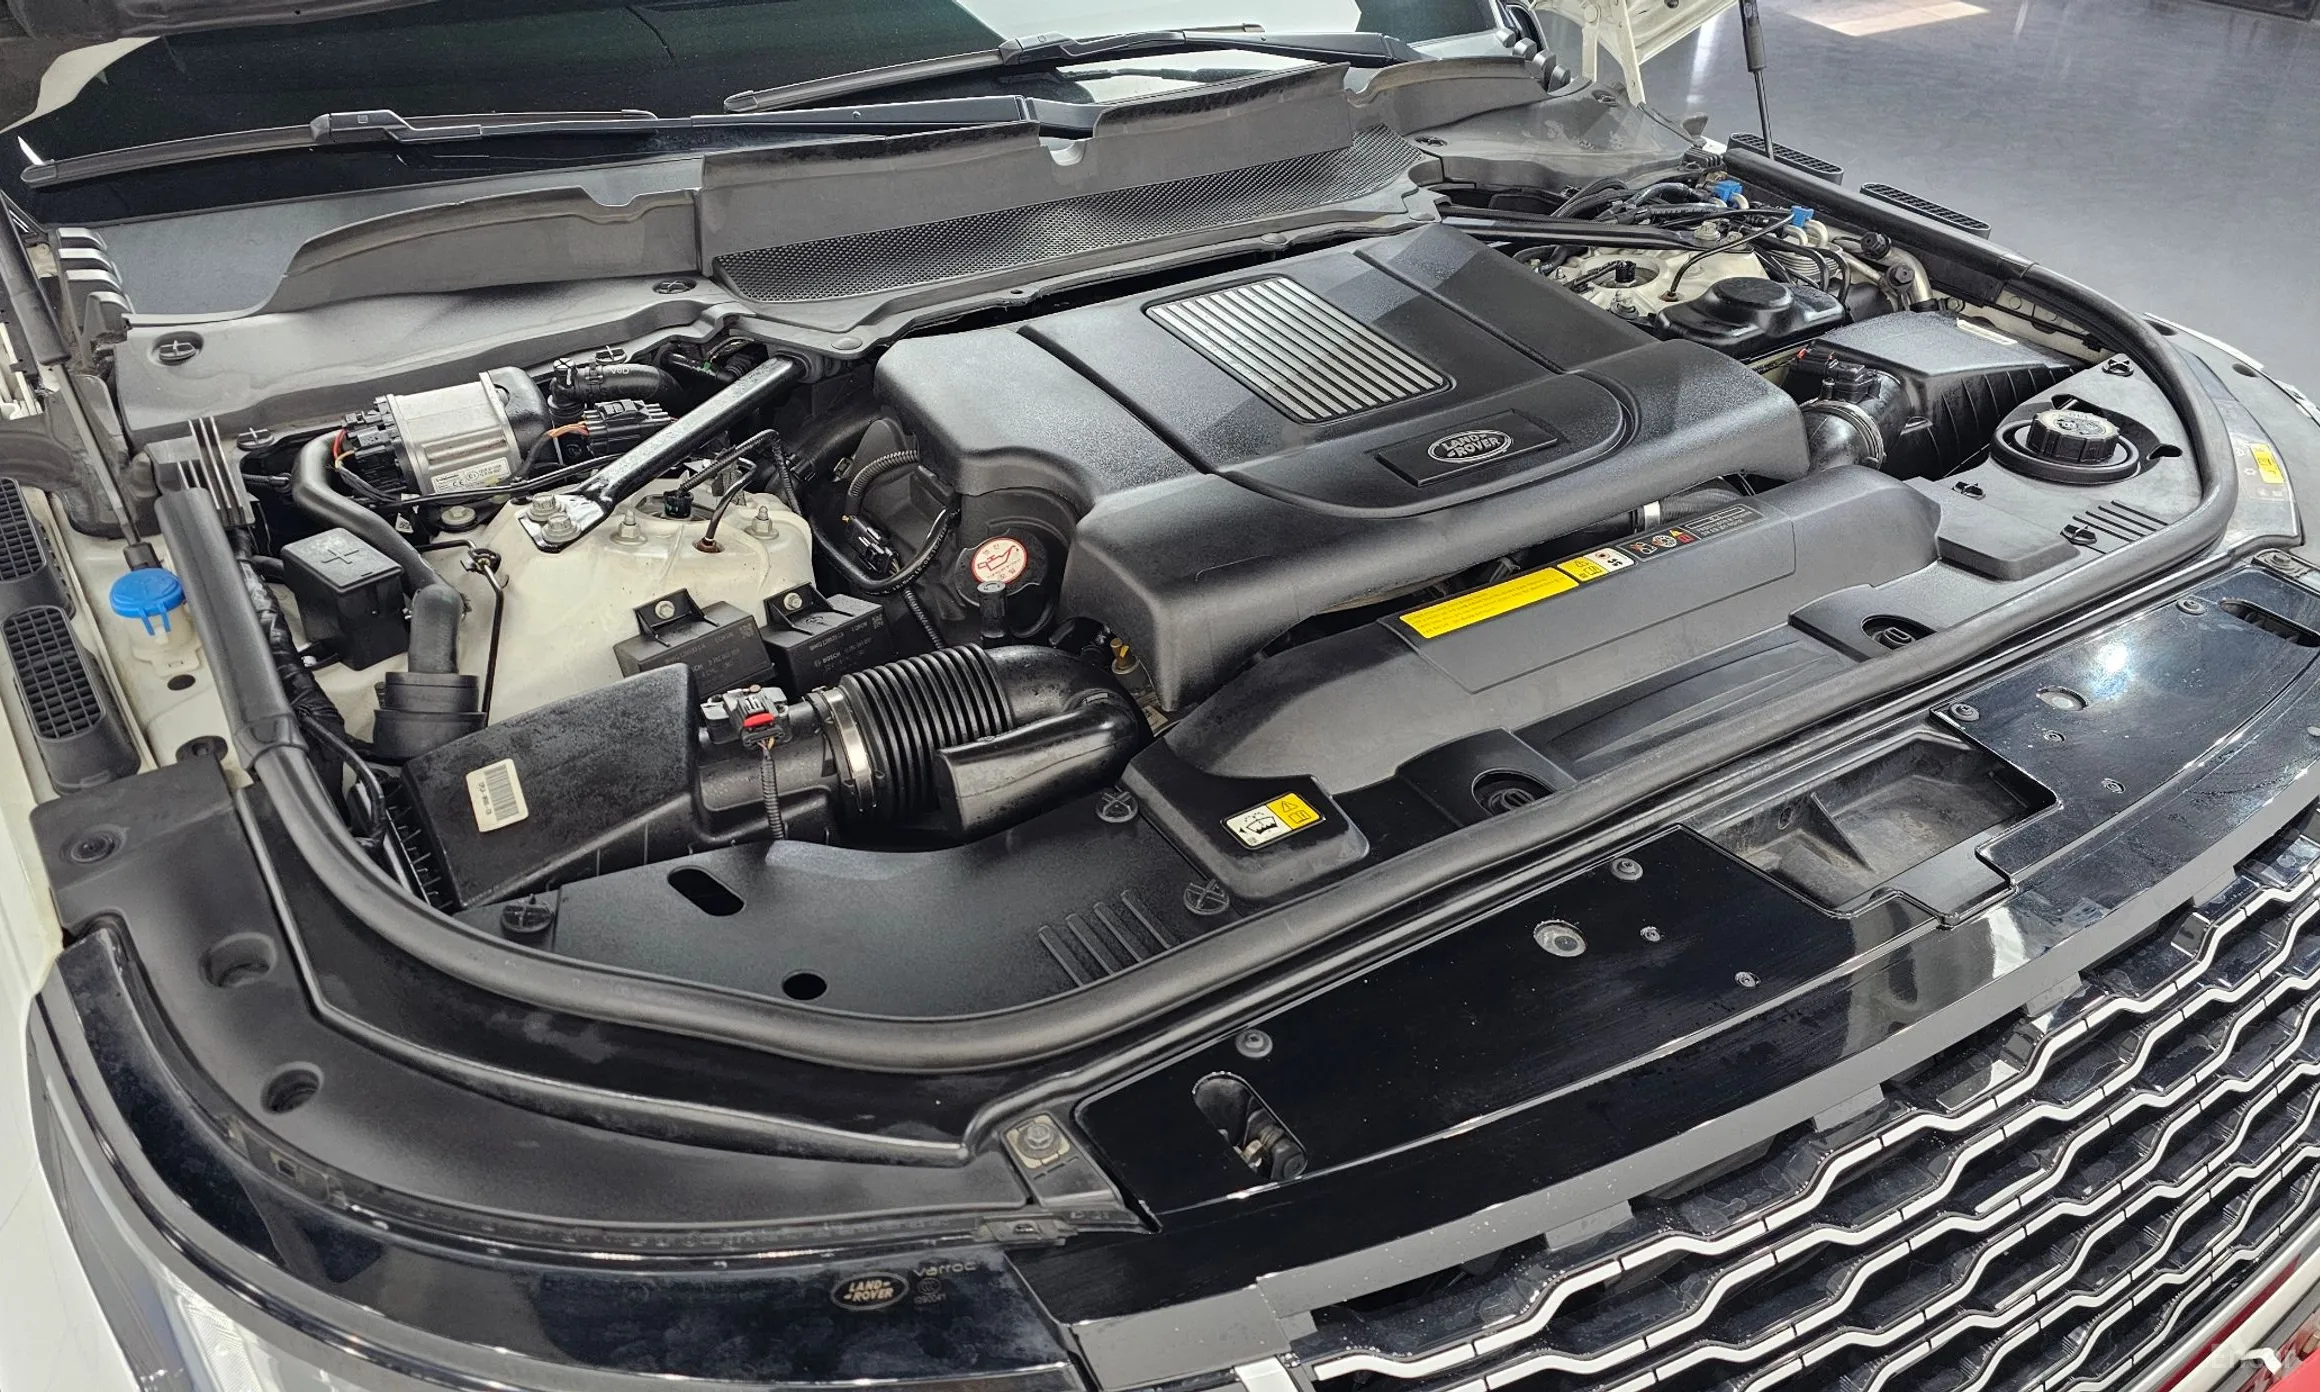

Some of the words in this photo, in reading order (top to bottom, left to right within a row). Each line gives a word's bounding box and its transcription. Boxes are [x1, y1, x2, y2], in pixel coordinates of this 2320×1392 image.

[1442, 434, 1480, 451] LAND
[1453, 437, 1501, 457] ROVER
[913, 1260, 977, 1277] varroc
[848, 1279, 884, 1293] LAND
[851, 1287, 894, 1302] ROVER
